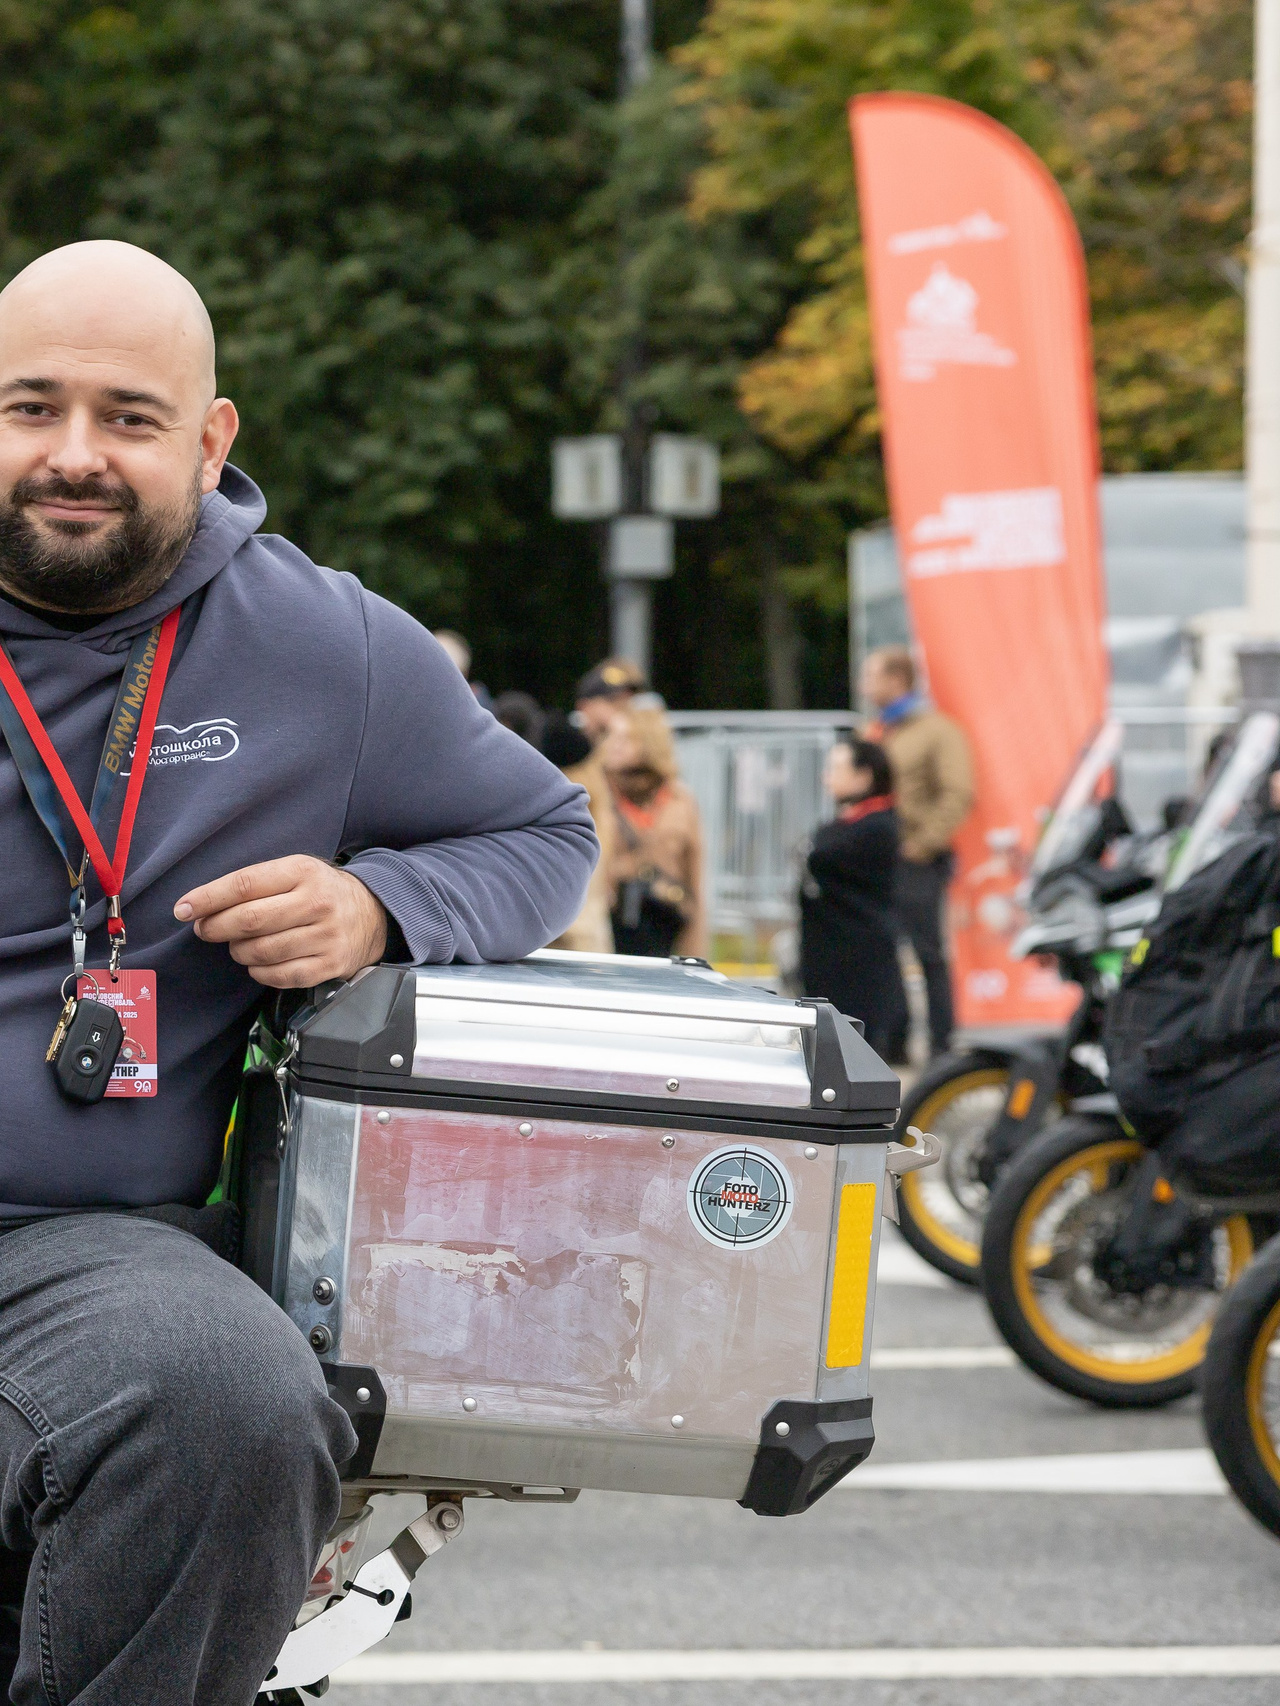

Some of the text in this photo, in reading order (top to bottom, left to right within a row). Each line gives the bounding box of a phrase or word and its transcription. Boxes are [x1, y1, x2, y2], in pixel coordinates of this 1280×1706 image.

[105, 707, 136, 774] BMW
[135, 735, 222, 758] тошкола
[112, 1066, 139, 1077] ТНЕР
[724, 1182, 758, 1194] FOTO
[708, 1196, 770, 1212] HUNTERZ
[721, 1190, 758, 1204] MOTO
